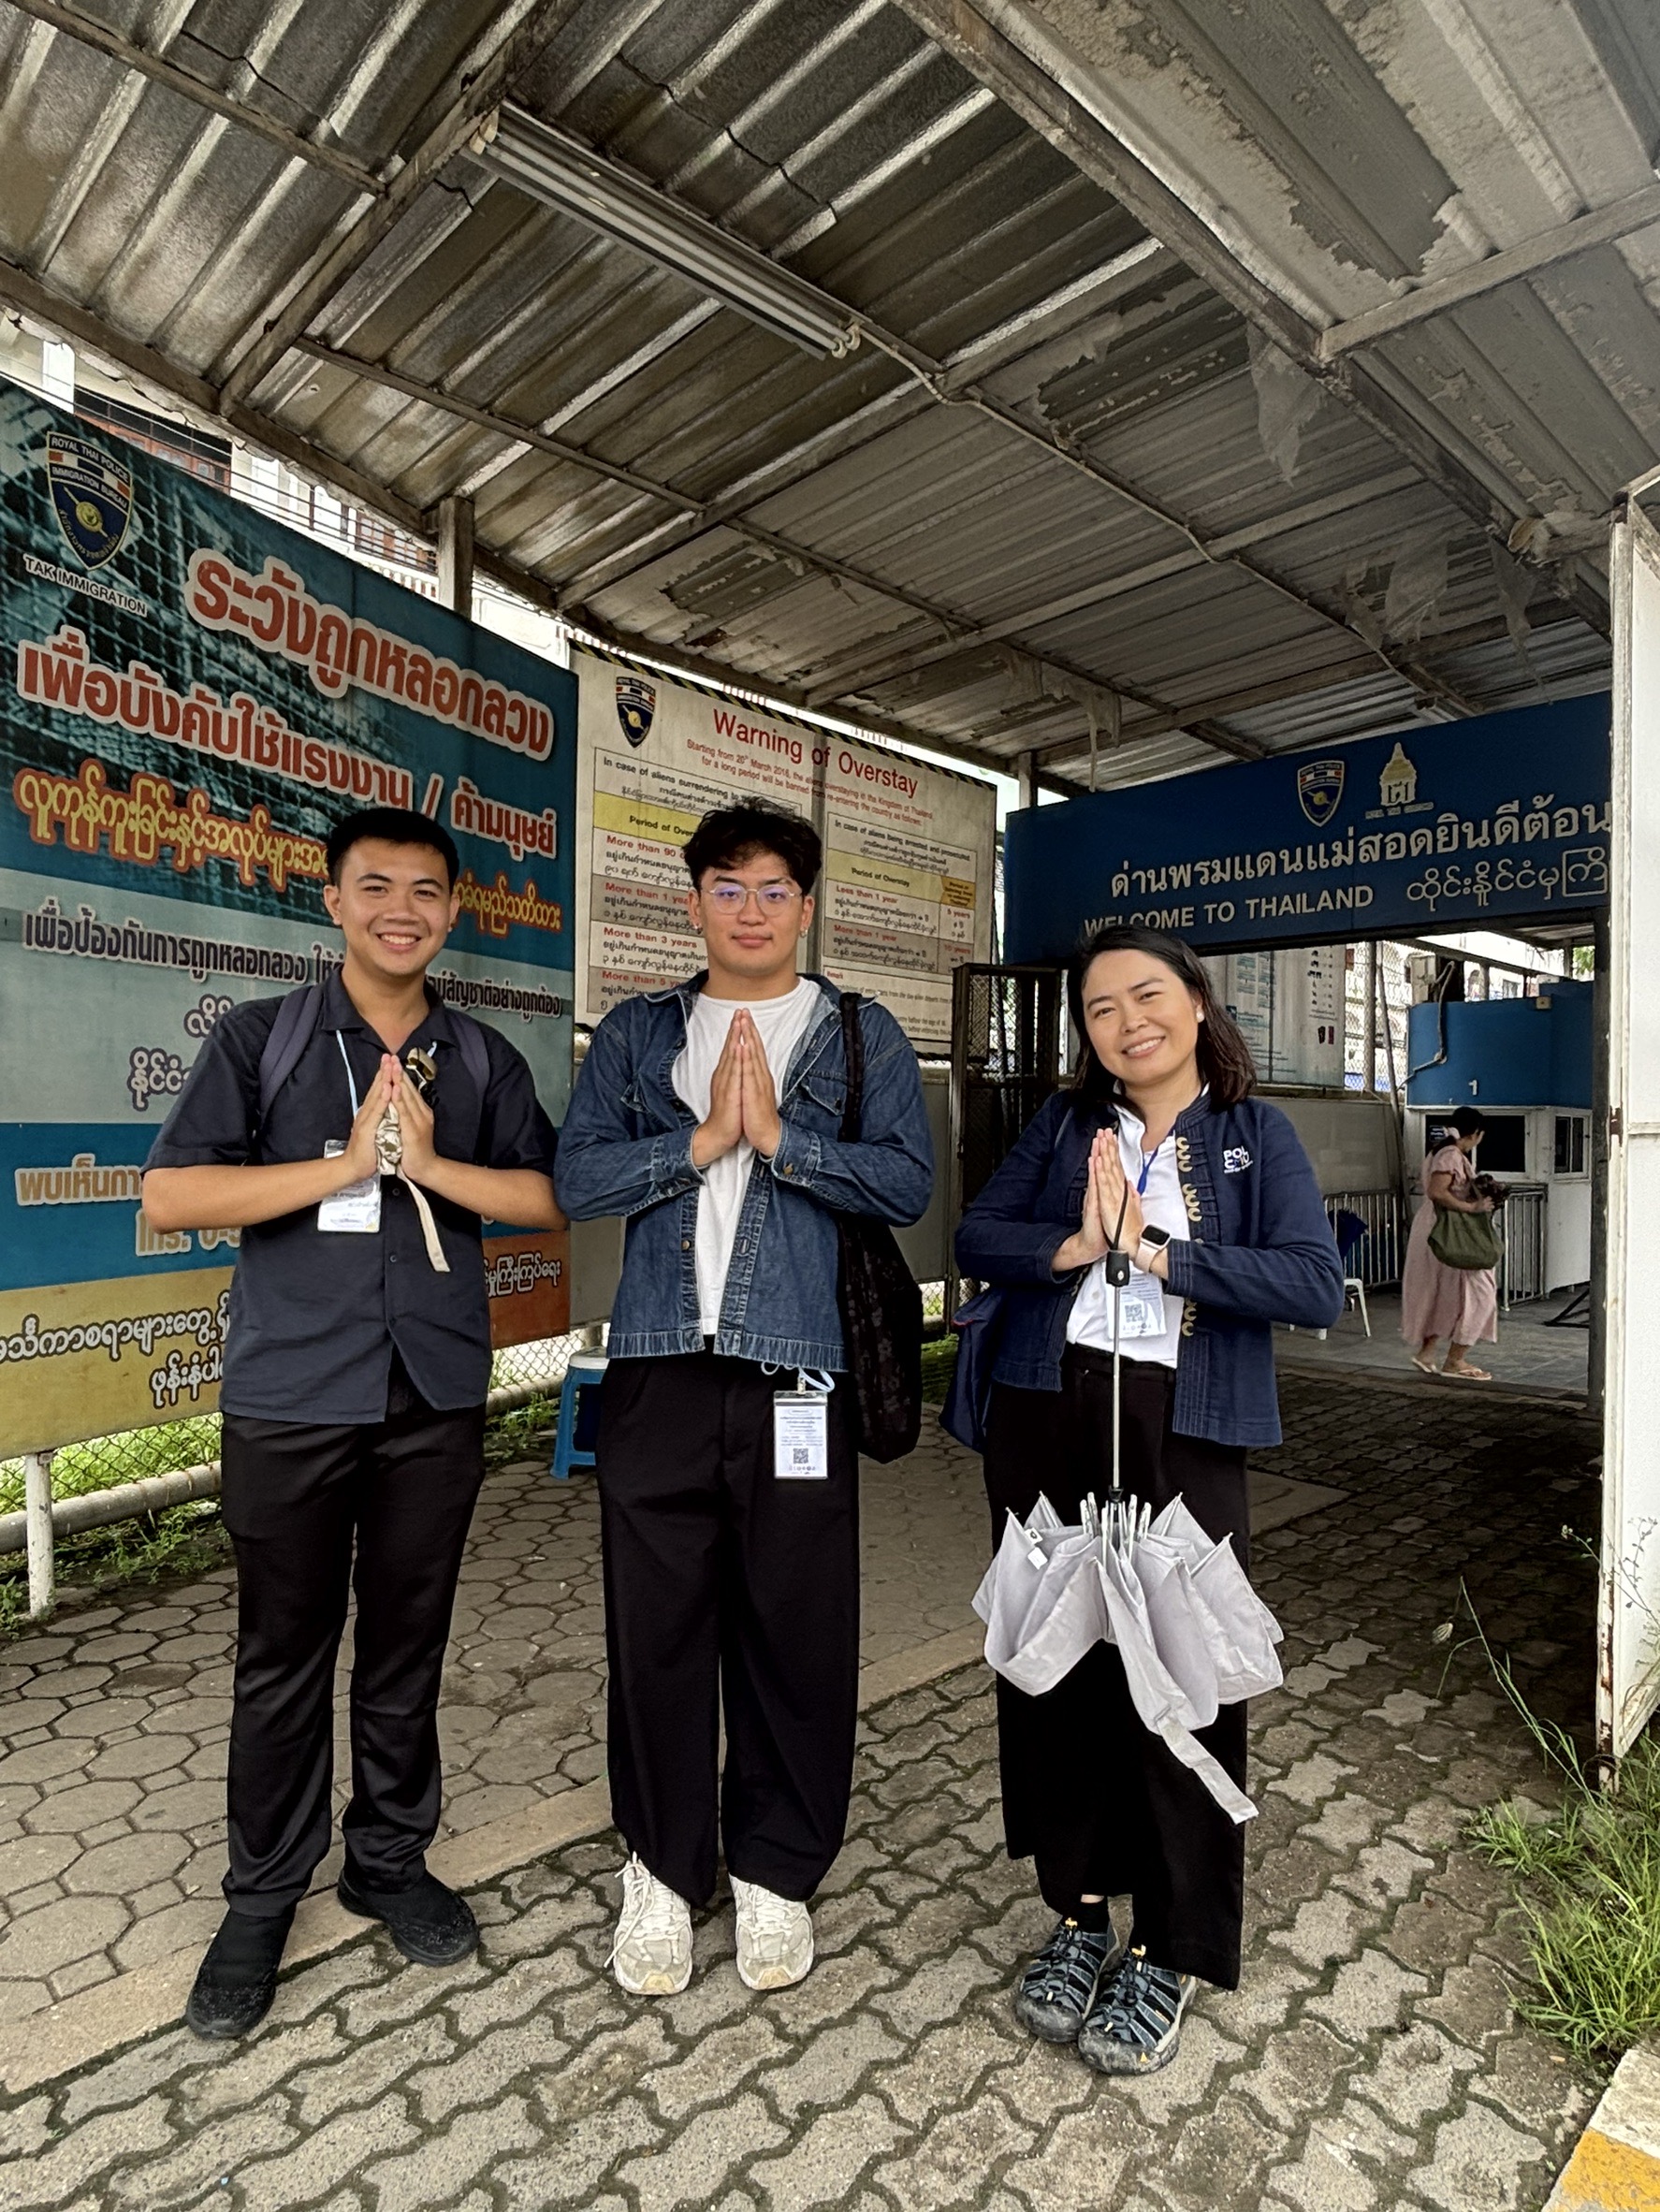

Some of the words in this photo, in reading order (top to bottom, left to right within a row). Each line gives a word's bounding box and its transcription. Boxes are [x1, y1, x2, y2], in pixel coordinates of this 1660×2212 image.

[51, 437, 80, 453] ROYAL
[81, 445, 99, 462] THAI
[101, 453, 129, 482] POLICE
[51, 467, 99, 490] IMMIGRATION
[100, 480, 128, 508] BUREAU
[24, 556, 54, 578] TAK
[57, 571, 147, 616] IMMIGRATION
[192, 558, 550, 755] ระวังถูกหลอกลวง
[23, 632, 410, 808] เพื่อบังคับใช้แรงงาน
[454, 780, 554, 857] ค้ามนุษย์
[687, 738, 716, 757] Starting
[718, 749, 735, 762] from
[750, 759, 772, 775] March
[713, 707, 803, 764] Warning
[811, 747, 831, 767] of
[838, 751, 918, 798] Overstay
[604, 756, 613, 767] In
[616, 762, 636, 774] case
[639, 766, 648, 777] of
[651, 771, 676, 784] aliens
[678, 779, 729, 800] surrendering
[702, 755, 712, 767] for
[721, 761, 736, 775] long
[738, 768, 760, 780] period
[785, 780, 809, 794] banned
[629, 815, 659, 830] Period
[662, 823, 671, 832] of
[674, 825, 695, 837] Over
[843, 822, 858, 833] case
[606, 835, 634, 849] More
[637, 842, 661, 854] than
[663, 847, 677, 857] 90
[1111, 793, 1611, 898] ด่านพรมแดนแม่สอดยินดีต้อน
[851, 866, 873, 880] Period
[604, 881, 633, 895] More
[636, 888, 659, 900] than
[672, 895, 689, 906] yea
[836, 885, 855, 896] Less
[856, 889, 873, 900] than
[882, 895, 899, 904] year
[1203, 901, 1235, 924] TO
[1245, 885, 1374, 920] THAILAND
[834, 924, 854, 935] More
[856, 928, 873, 938] than
[953, 910, 971, 919] years
[25, 898, 307, 981] เพื่อป้องกันการถูกหลอกลวง
[604, 926, 632, 939] More
[634, 932, 658, 942] than
[661, 936, 668, 944] 3
[671, 938, 698, 949] years
[602, 970, 629, 982] More
[633, 974, 657, 985] than
[1468, 1079, 1478, 1096] 1
[152, 1345, 224, 1406] ဖုန်းနံပါ
